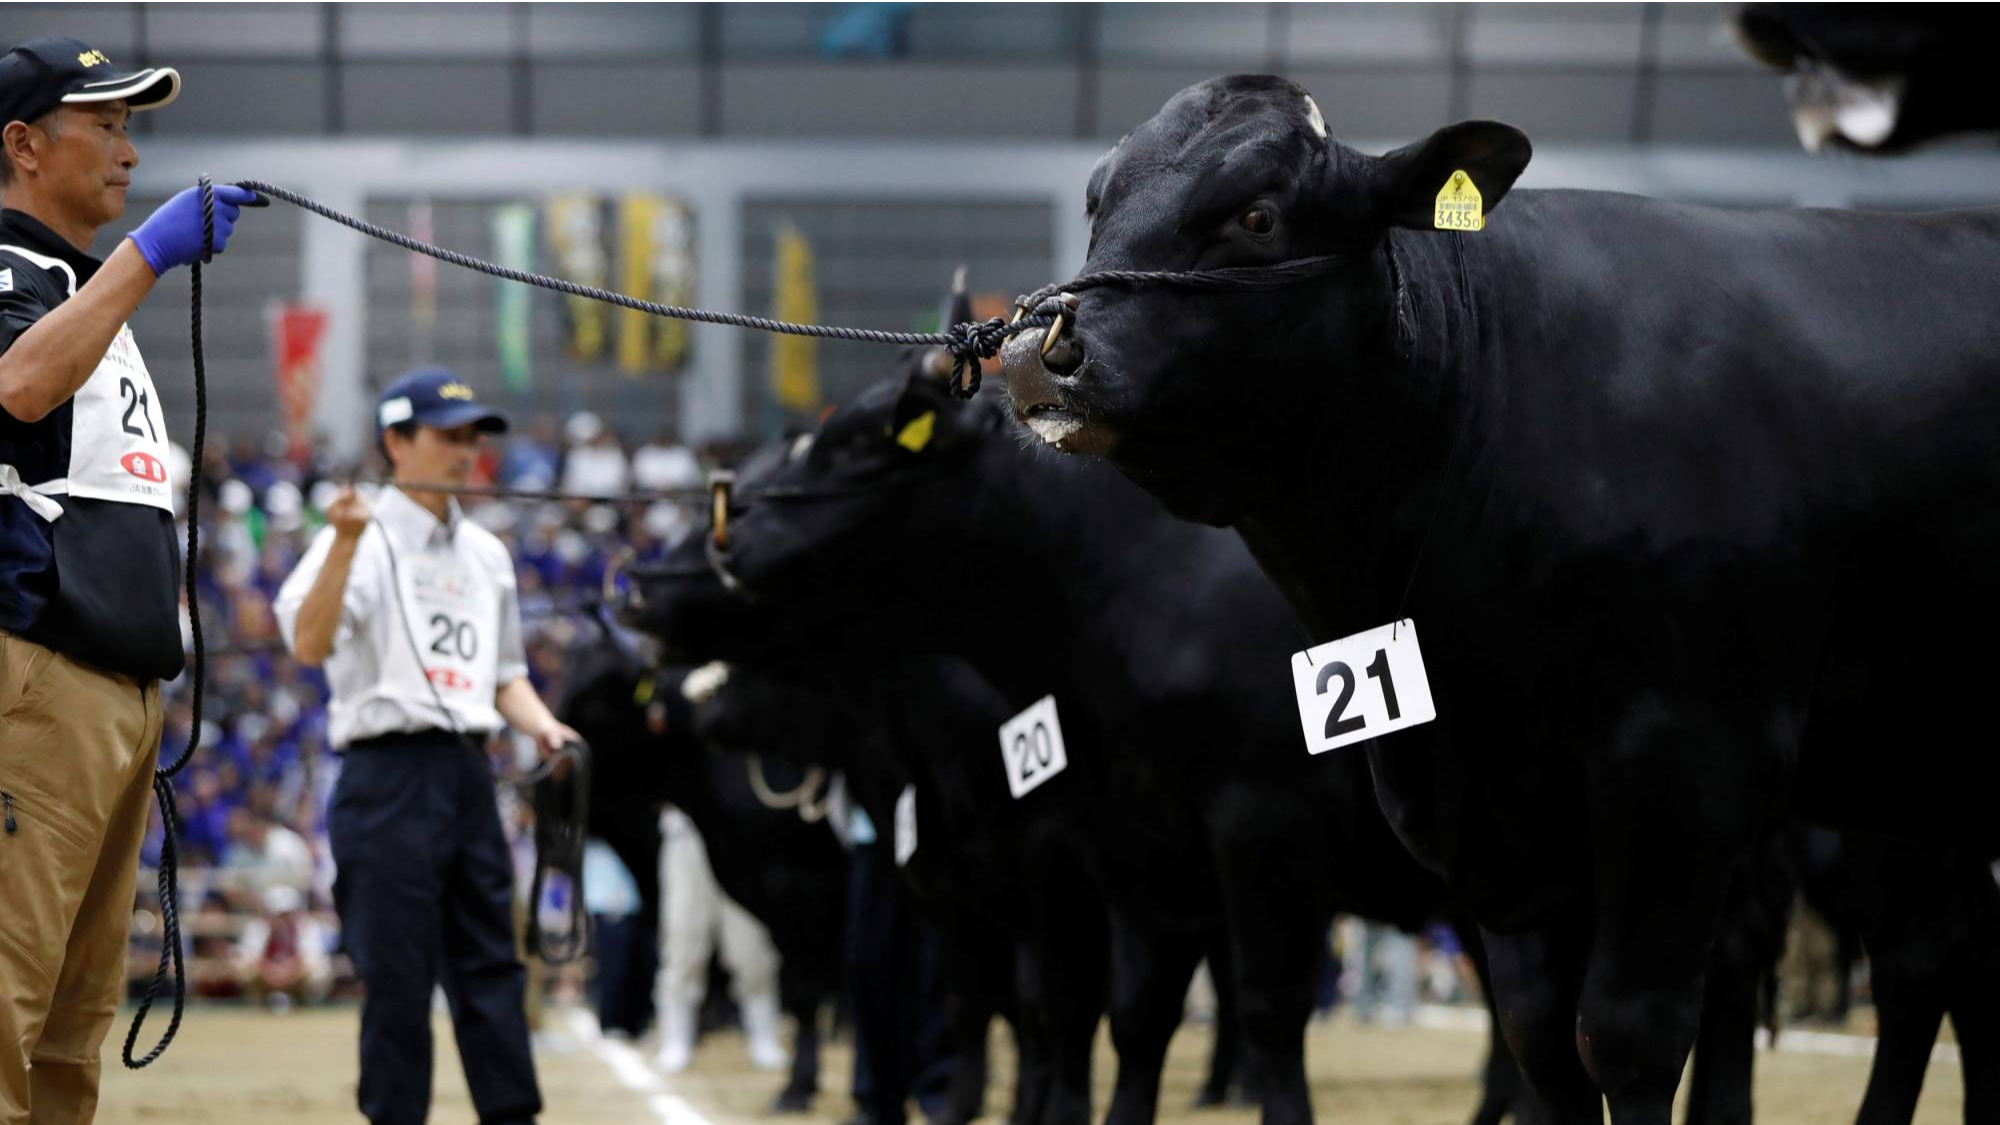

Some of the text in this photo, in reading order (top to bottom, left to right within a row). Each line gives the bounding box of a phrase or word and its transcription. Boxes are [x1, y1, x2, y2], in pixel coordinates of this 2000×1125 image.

[120, 377, 158, 443] 21
[430, 613, 478, 661] 20
[1316, 648, 1401, 739] 21
[1013, 721, 1052, 780] 20
